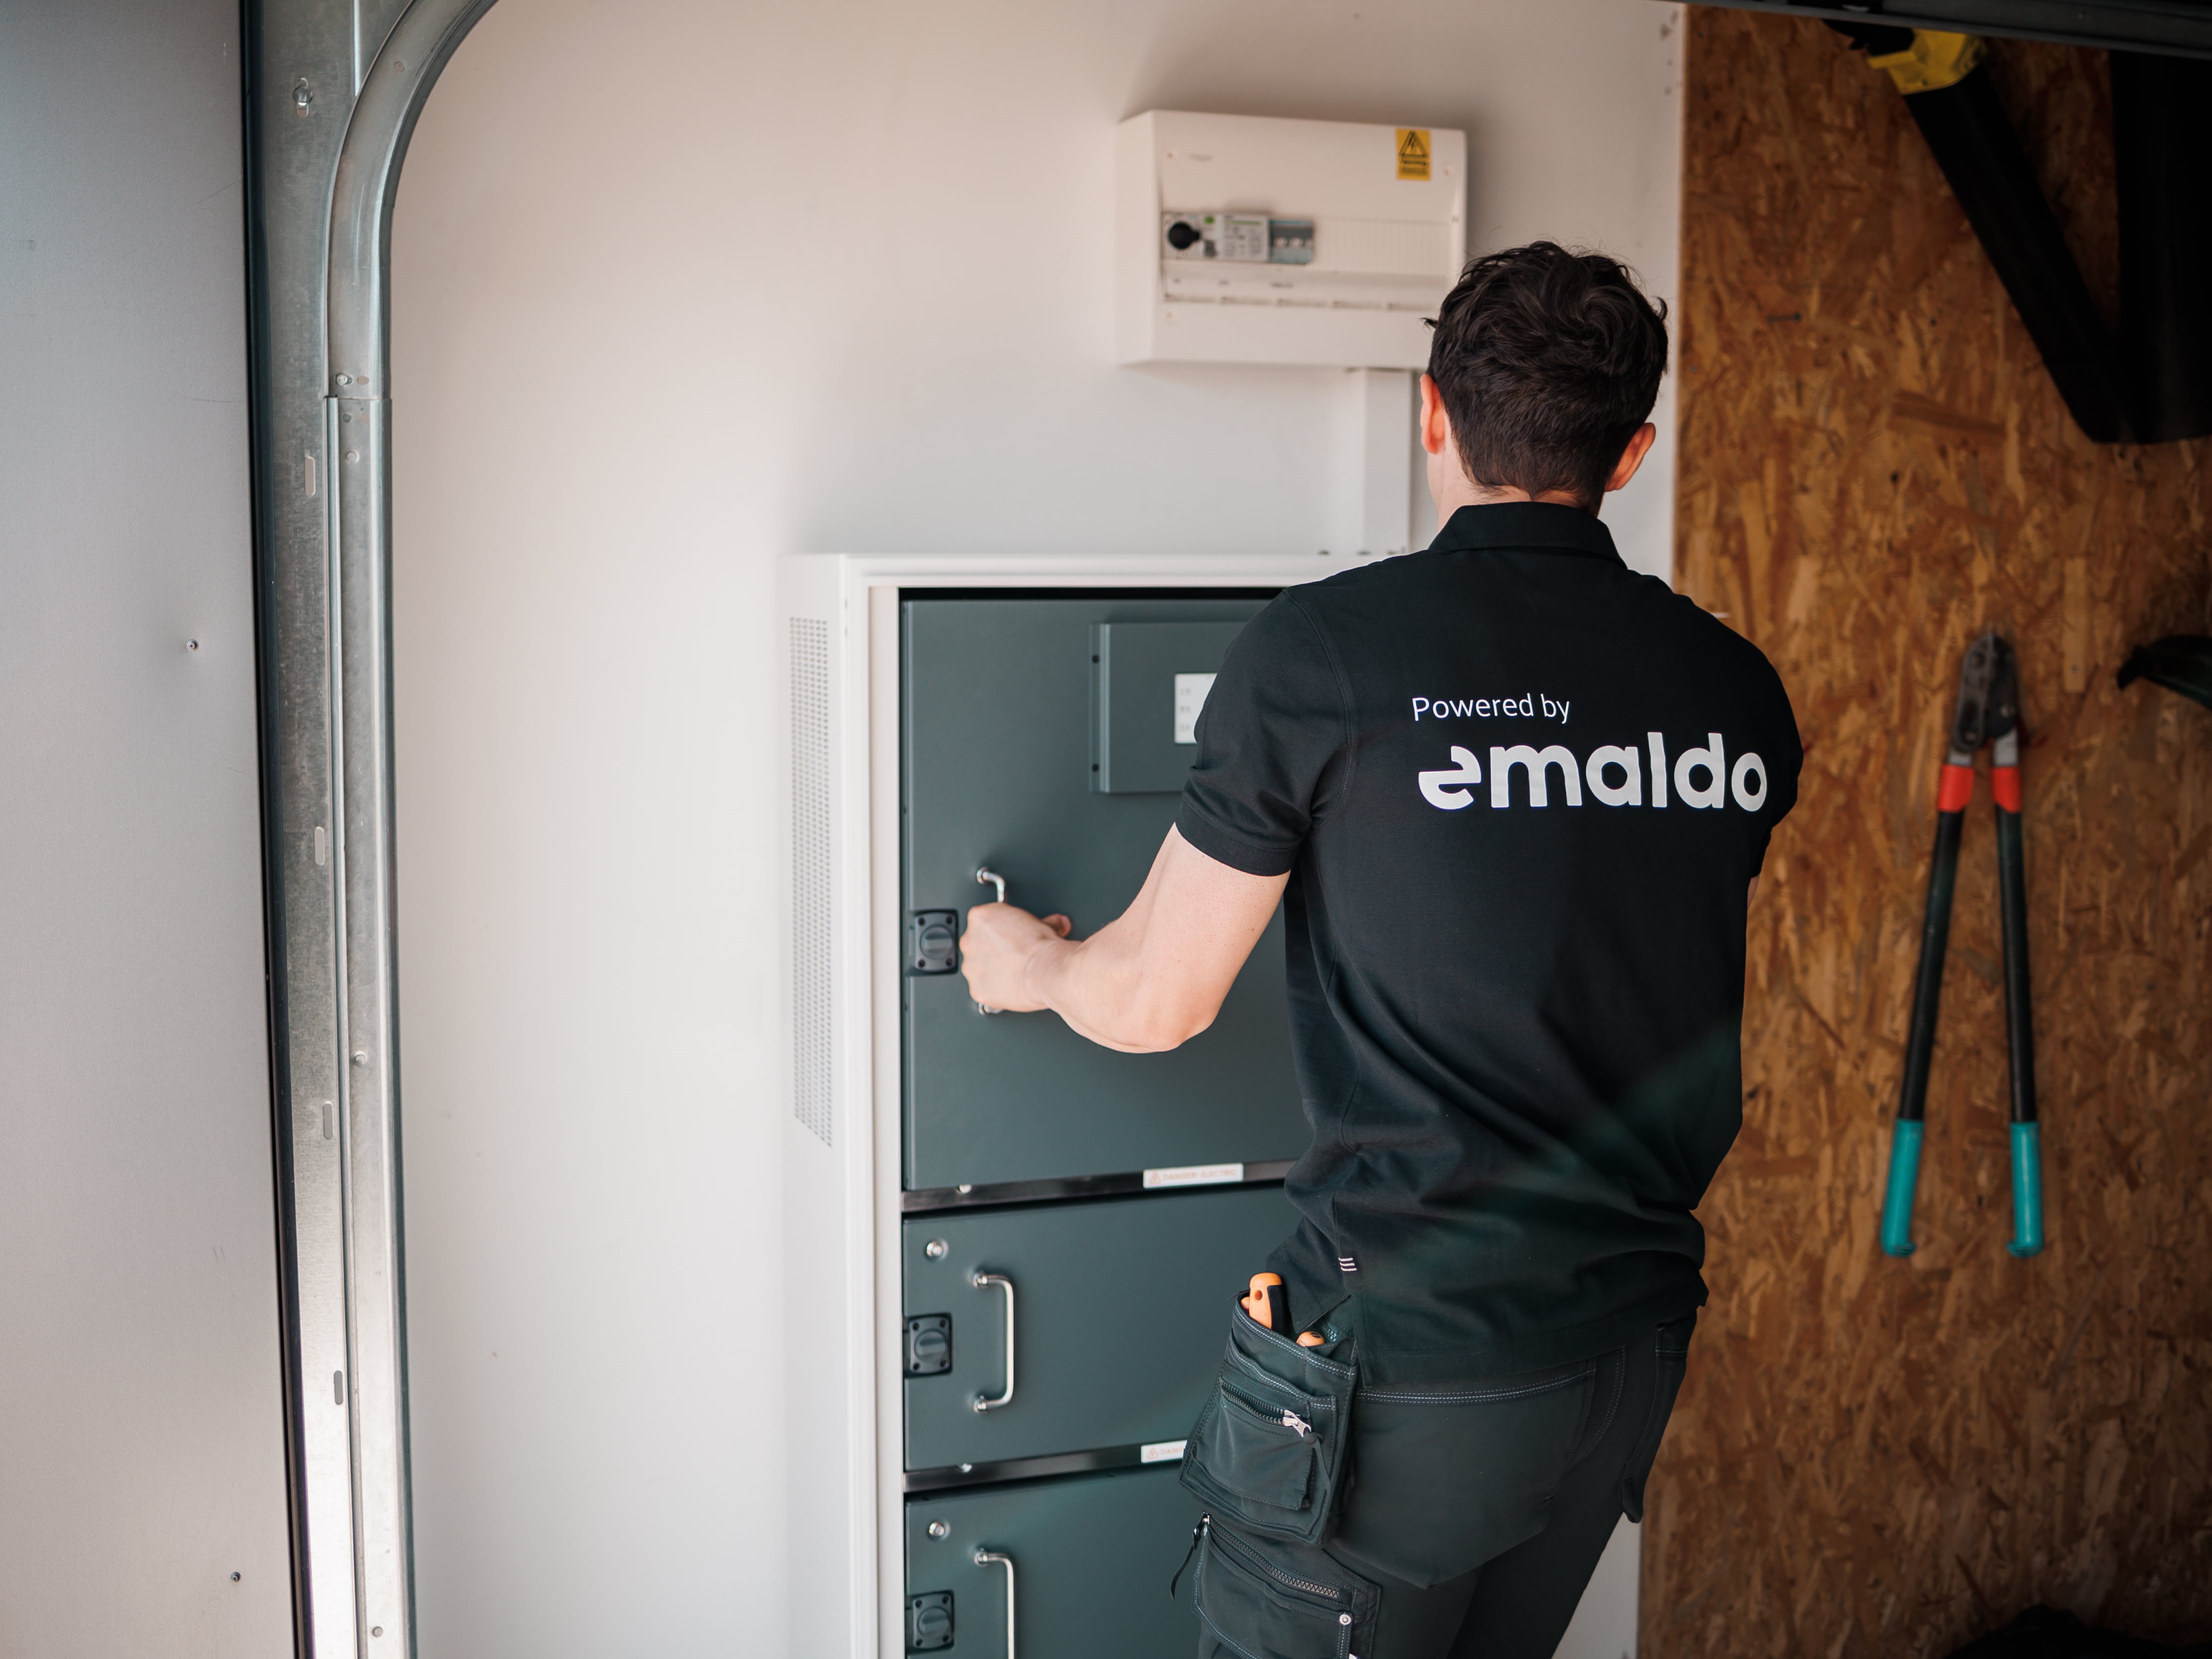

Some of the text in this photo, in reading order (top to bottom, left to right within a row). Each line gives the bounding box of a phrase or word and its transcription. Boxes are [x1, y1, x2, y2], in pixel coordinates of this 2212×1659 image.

[1412, 692, 1570, 725] Powered by
[1418, 732, 1767, 812] emaldo
